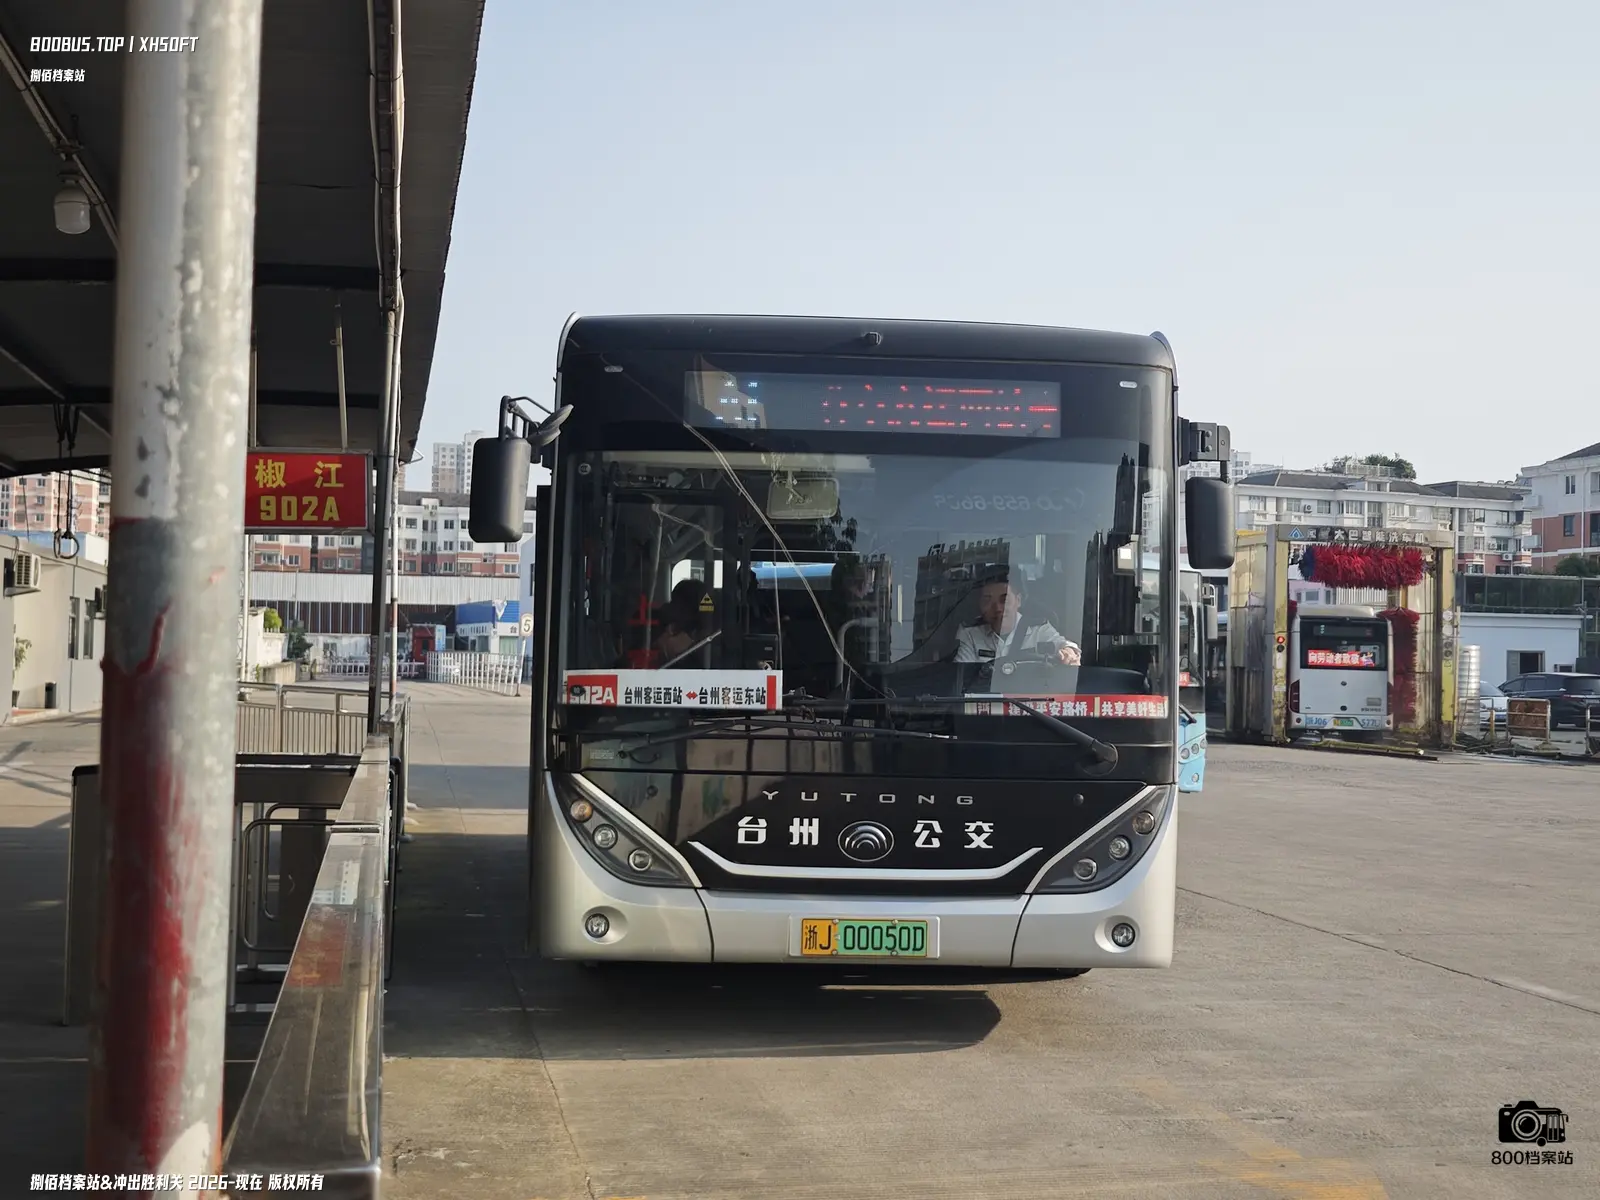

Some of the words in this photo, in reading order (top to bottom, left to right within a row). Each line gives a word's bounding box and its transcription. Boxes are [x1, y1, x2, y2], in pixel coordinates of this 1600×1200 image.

[255, 459, 344, 488] 椒江
[260, 496, 340, 521] 902A
[523, 619, 531, 632] 5
[624, 686, 682, 704] 台州客运西站
[699, 687, 766, 705] 台州客运东站
[763, 790, 973, 805] YUTONG
[737, 816, 819, 845] 台州
[914, 820, 993, 848] 公交
